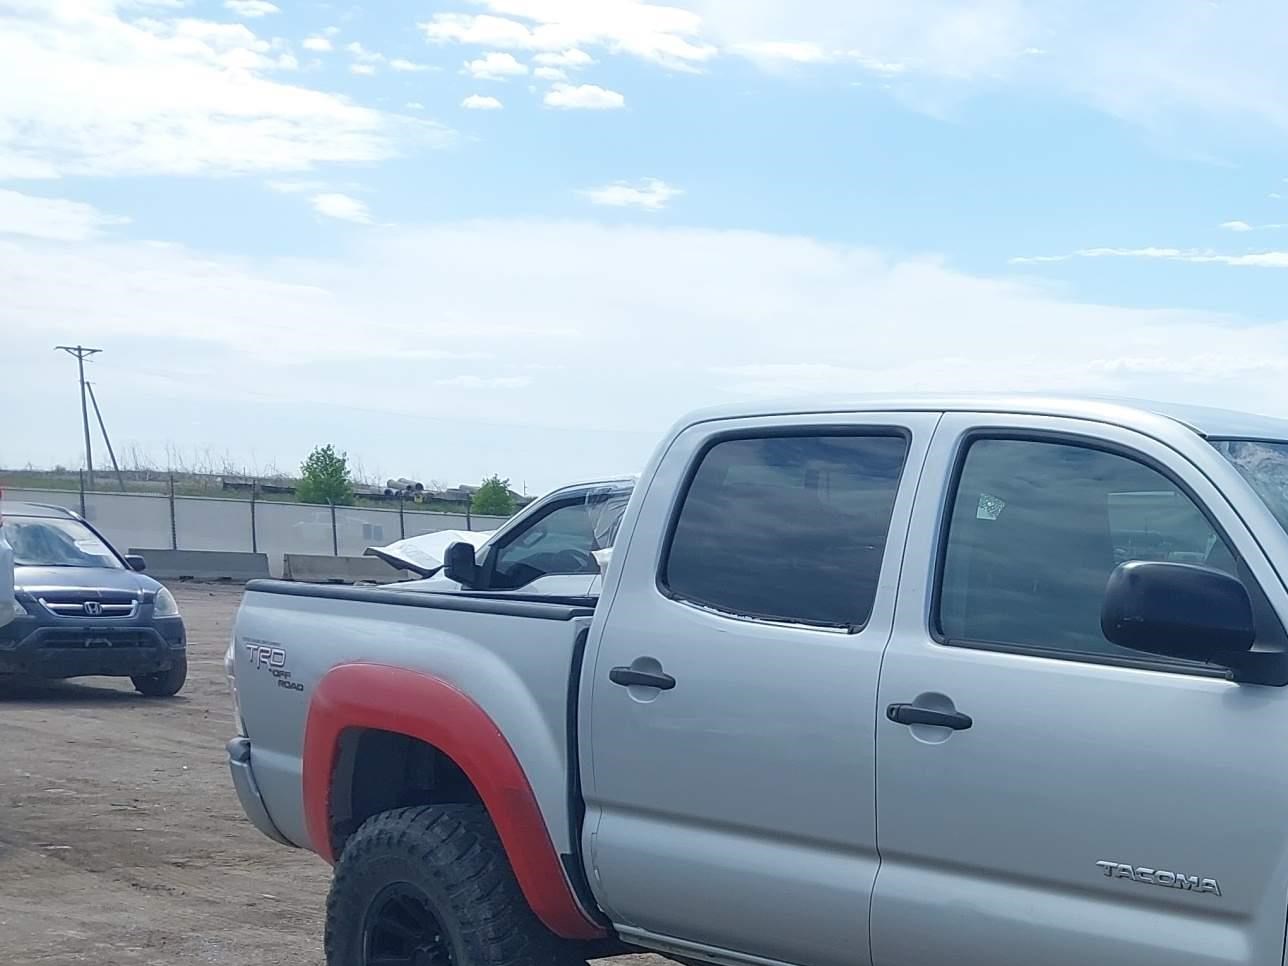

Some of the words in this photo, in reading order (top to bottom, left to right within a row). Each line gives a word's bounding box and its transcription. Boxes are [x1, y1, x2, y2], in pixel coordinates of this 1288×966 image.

[245, 642, 287, 670] TRD
[272, 669, 292, 679] OFF
[278, 679, 304, 692] ROAD
[1095, 859, 1223, 897] TACOMA
